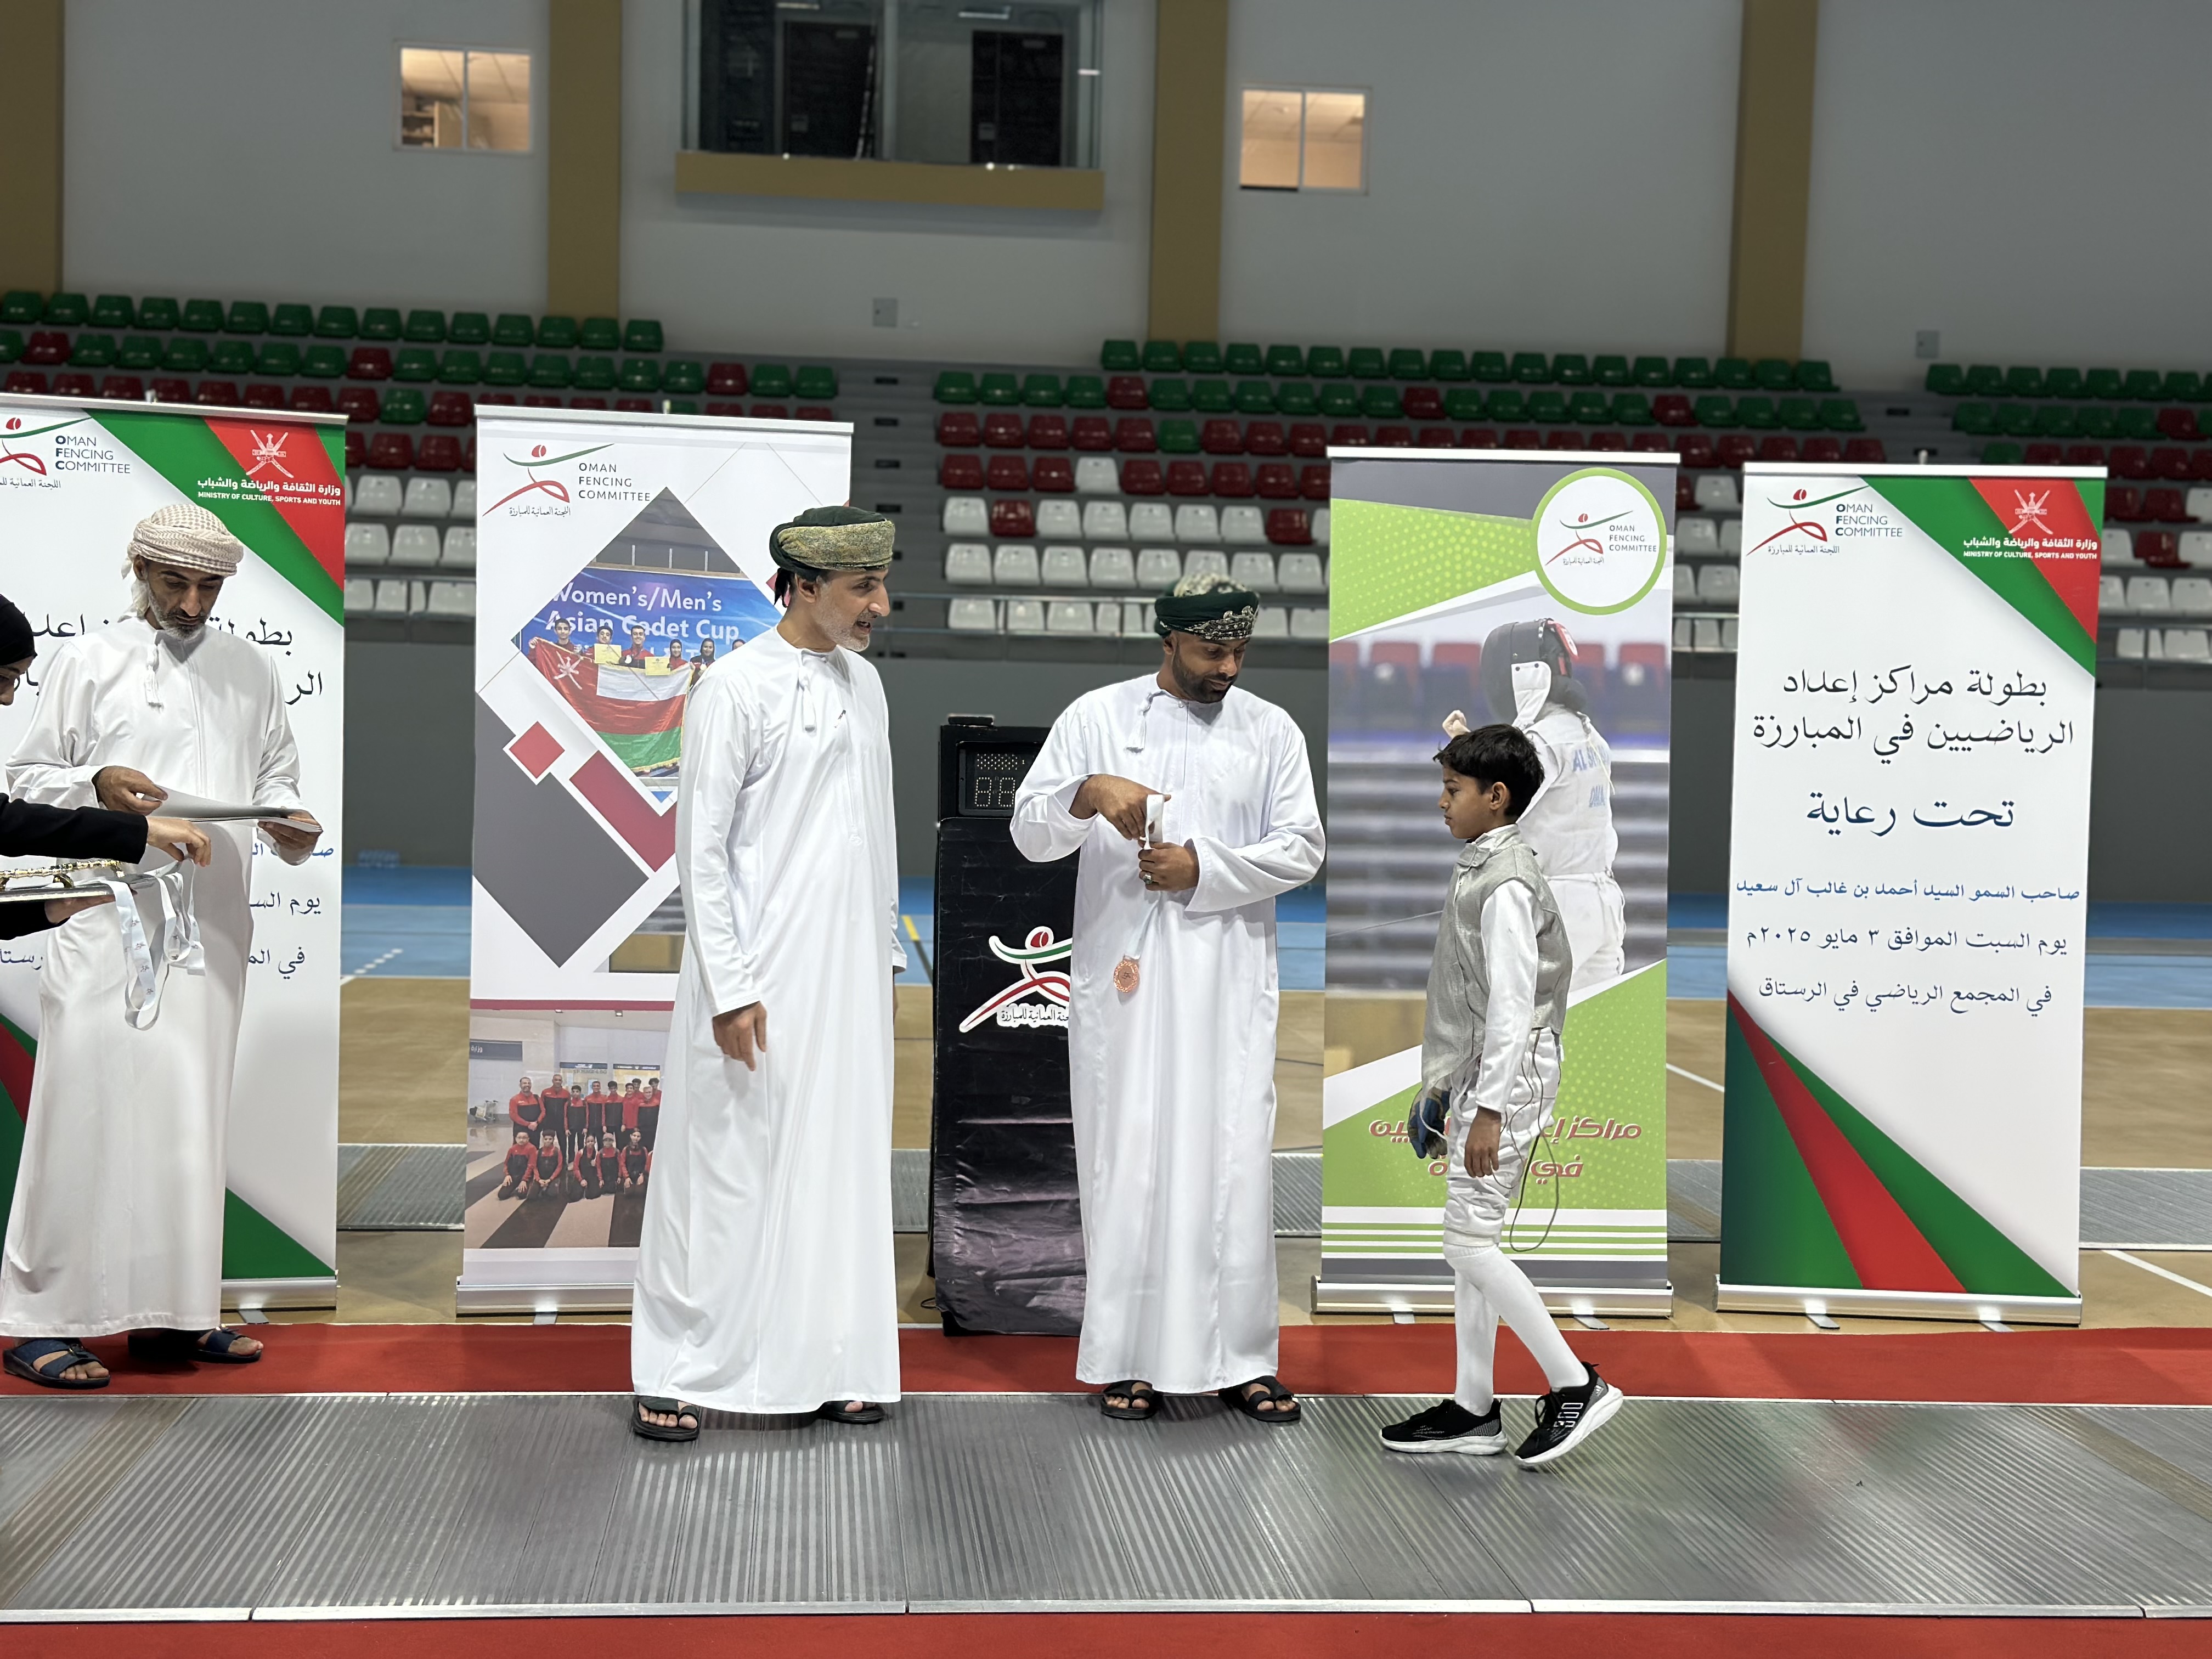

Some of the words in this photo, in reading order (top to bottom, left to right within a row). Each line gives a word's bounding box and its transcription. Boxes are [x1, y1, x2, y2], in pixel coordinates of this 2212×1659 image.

[55, 435, 97, 447] OMAN
[55, 448, 114, 460] FENCING
[55, 460, 131, 473] COMMITTEE
[579, 462, 617, 472] OMAN
[10, 478, 36, 489] العمانية
[38, 479, 61, 490] اللجنة
[197, 476, 238, 489] والشباب
[240, 479, 280, 492] والرياضة
[282, 482, 315, 493] الثقافة
[318, 484, 341, 496] وزارة
[579, 476, 632, 487] FENCING
[241, 494, 274, 503] CULTURE,
[578, 490, 650, 501] COMMITTEE
[531, 506, 553, 517] العمانية
[554, 506, 571, 517] اللجنة
[1836, 504, 1873, 513] OMAN
[1836, 515, 1888, 525] FENCING
[1835, 527, 1903, 537] COMMITTEE
[1768, 544, 1792, 555] للمبارزة
[1820, 545, 1839, 555] اللجنة
[1963, 535, 2000, 548] والشباب
[2003, 537, 2040, 549] والرياضة
[2042, 538, 2073, 548] الثقافة
[2075, 539, 2097, 550] وزارة
[1795, 545, 1818, 556] العمانية
[545, 610, 613, 634] Asian
[621, 615, 689, 638] Cadet
[696, 619, 740, 645] Cup
[1784, 669, 1858, 703] إعداد
[1865, 664, 1953, 705] مراكز
[1966, 669, 2046, 707] بطولة
[1753, 715, 1862, 748] المبارزة
[1874, 713, 1914, 764] في
[1927, 719, 2073, 753] الرياضيين
[1807, 791, 1897, 837] رعاية
[1913, 799, 2015, 828] تحت
[1736, 880, 1778, 897] سعيد
[1784, 877, 1803, 896] آل
[1806, 881, 1847, 898] غالب
[1854, 883, 1869, 900] بن
[1875, 880, 1918, 897] أحمد
[1923, 884, 1964, 900] السيد
[1968, 883, 2015, 901] السمو
[2021, 883, 2080, 903] صاحب
[250, 891, 280, 909] الس
[290, 896, 321, 916] يوم
[1819, 929, 1858, 950] مايو
[1868, 929, 1880, 946] ٣
[1887, 930, 1957, 952] الموافق
[1966, 931, 2030, 955] السبت
[2038, 936, 2067, 956] يوم
[278, 946, 305, 980] في
[1759, 977, 1827, 1001] الرستاق
[1833, 980, 1859, 1012] في
[1865, 983, 1943, 1009] الرياضي
[1950, 987, 2019, 1014] المجمع
[2025, 985, 2052, 1018] في
[1001, 1008, 1026, 1022] للمبارزة
[1029, 1009, 1056, 1022] العمانية
[1566, 1115, 1643, 1141] مراكز
[1530, 1154, 1584, 1184] في
